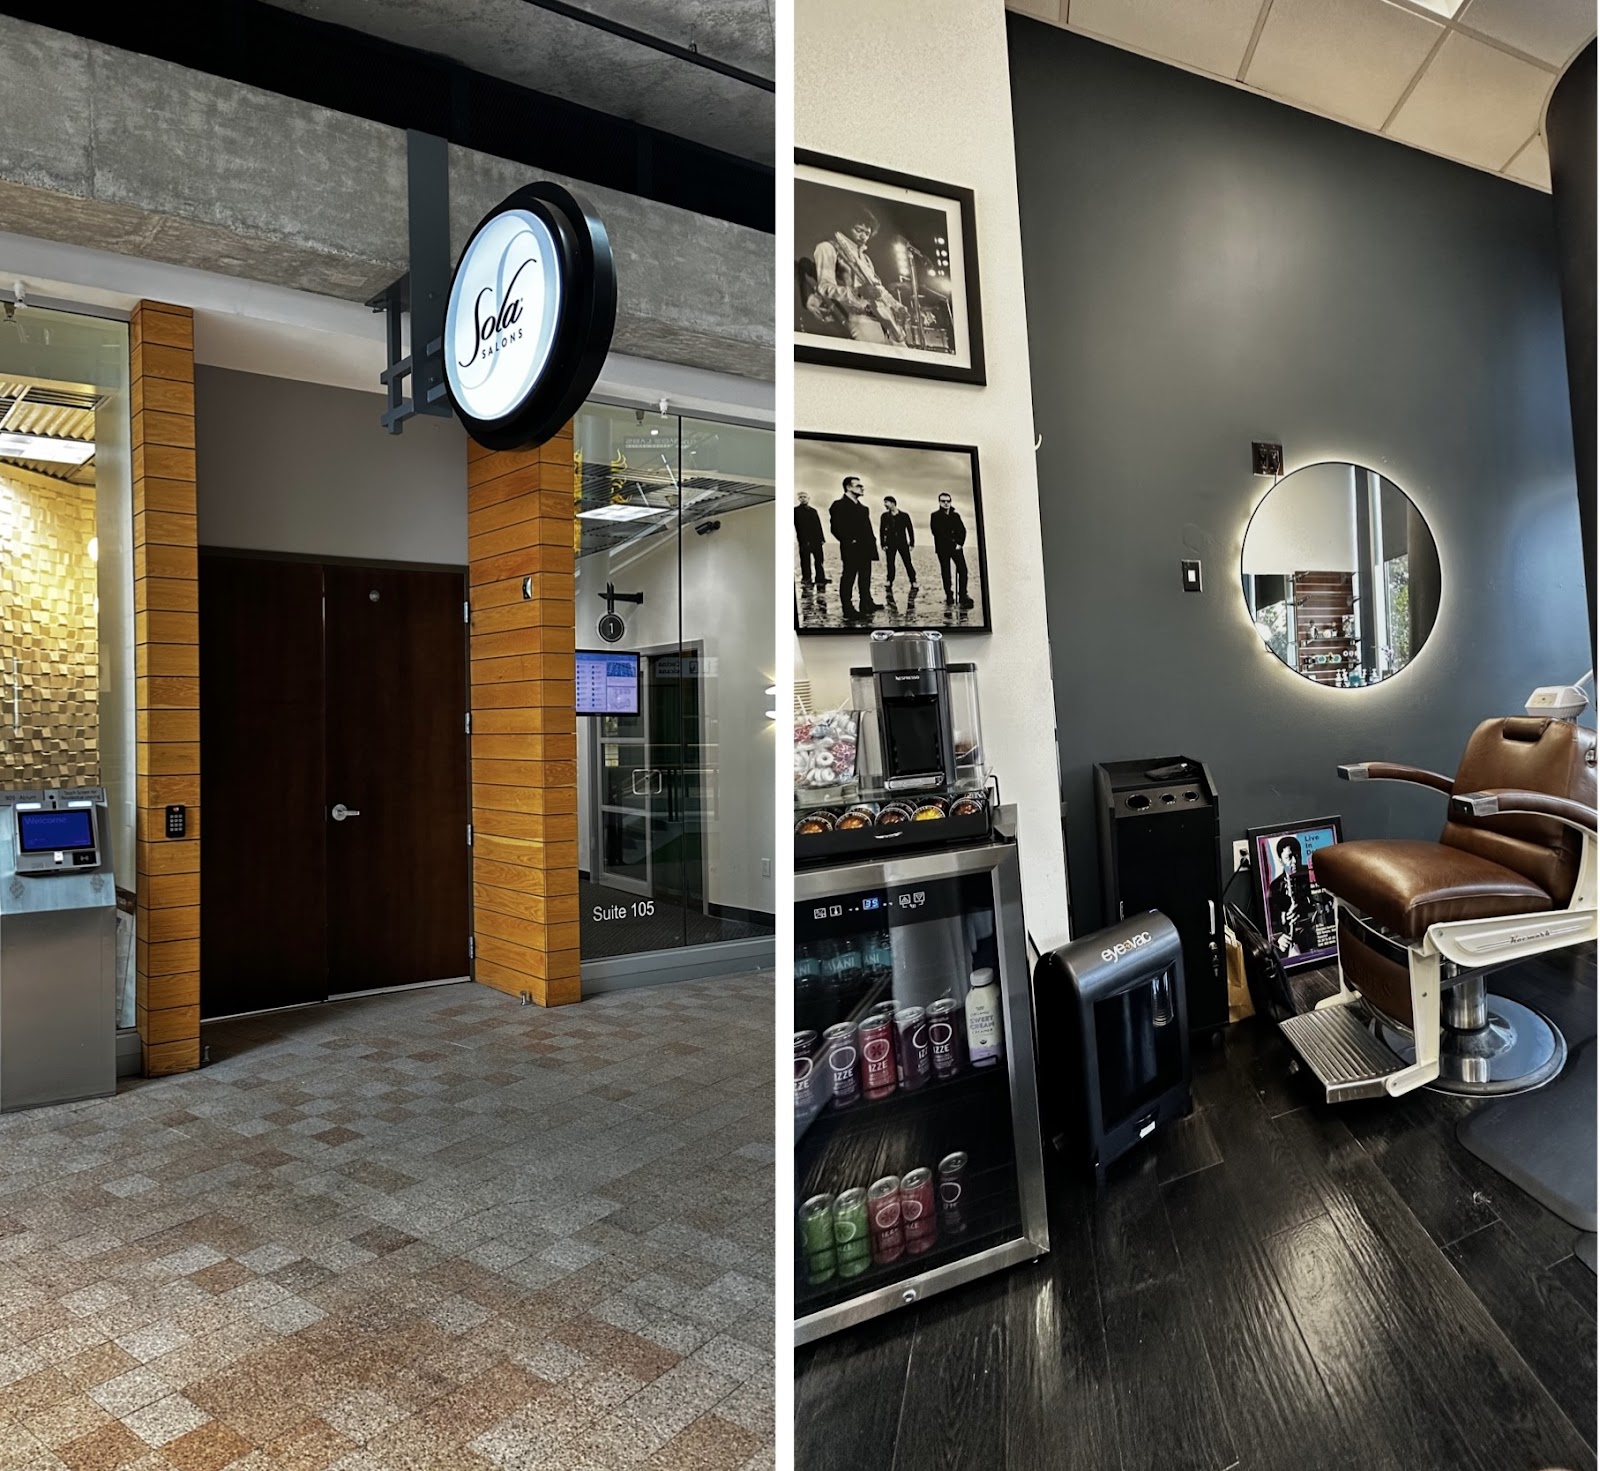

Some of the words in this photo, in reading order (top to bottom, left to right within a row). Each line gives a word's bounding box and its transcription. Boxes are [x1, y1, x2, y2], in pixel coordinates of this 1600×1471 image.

[458, 258, 537, 368] Sola
[481, 328, 523, 359] SALONS
[608, 622, 614, 635] 1
[592, 905, 627, 922] Suite
[631, 900, 655, 918] 105
[969, 1015, 994, 1024] SWEET
[969, 1021, 995, 1030] CREAM
[932, 1044, 950, 1054] IZZE
[868, 1059, 888, 1073] IZZE
[833, 1068, 854, 1082] IZZE
